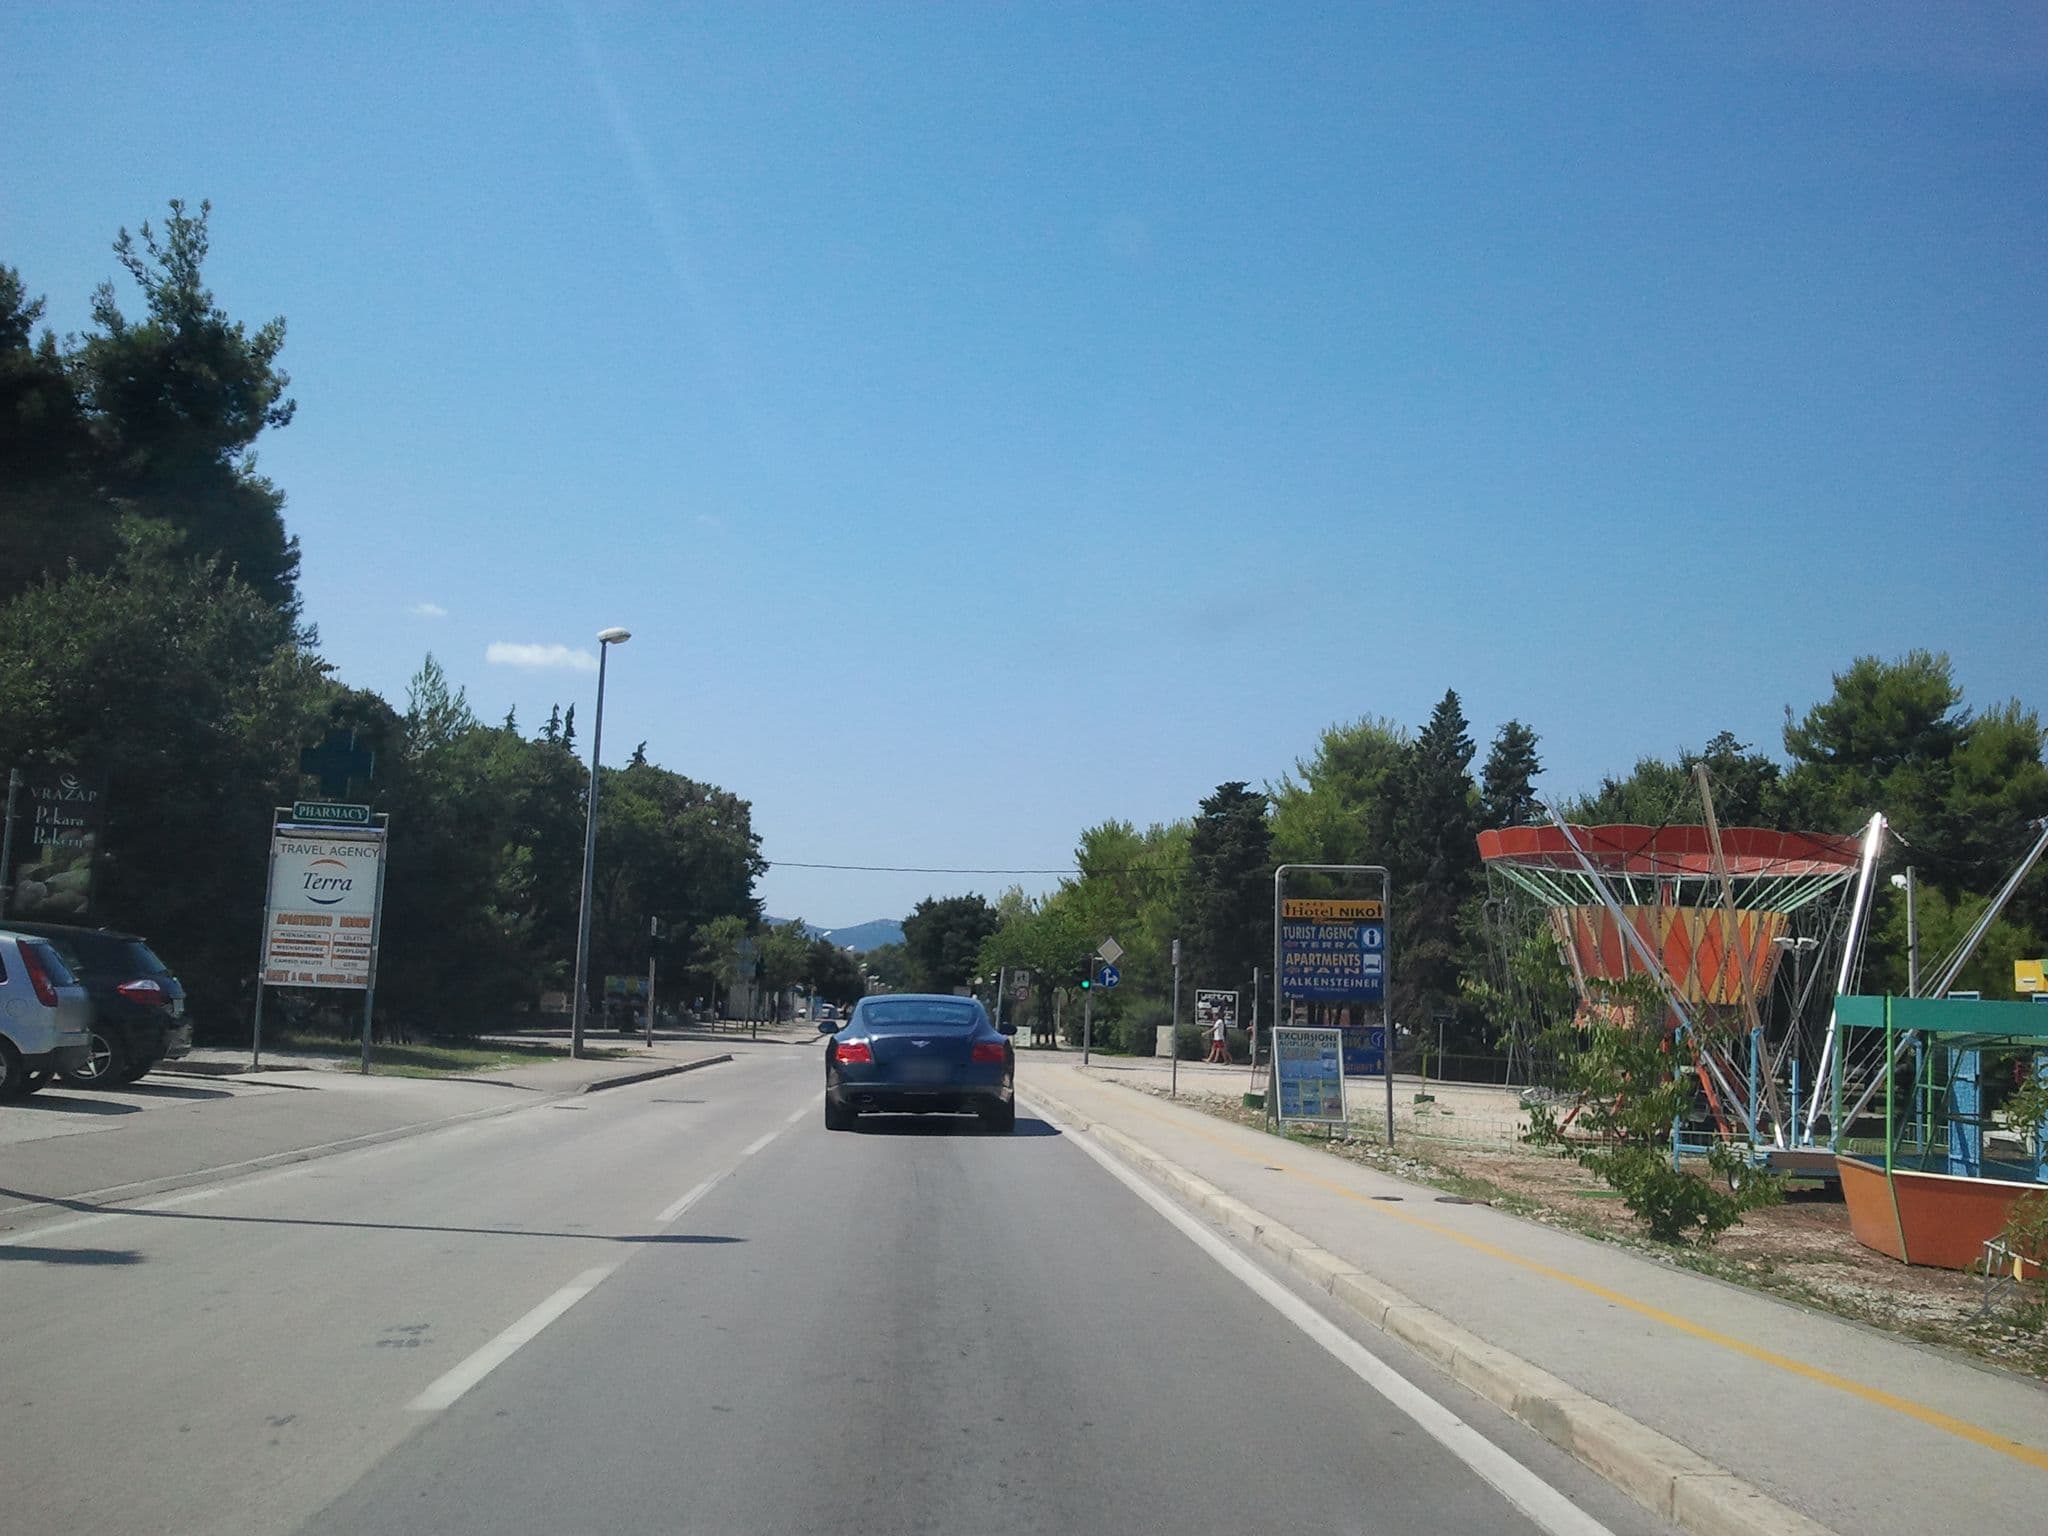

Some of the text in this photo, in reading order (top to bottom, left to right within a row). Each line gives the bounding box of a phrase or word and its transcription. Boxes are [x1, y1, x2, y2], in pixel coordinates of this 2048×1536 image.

[36, 806, 84, 826] Pekara
[298, 805, 365, 819] PHARMACY
[34, 826, 83, 848] Bakery
[280, 843, 380, 858] TRAVEL AGENCY
[303, 872, 352, 891] Terra
[1292, 906, 1375, 917] Hotel NIKO
[1283, 926, 1359, 940] TURIST AGENCY
[1300, 941, 1359, 949] TERRA
[1285, 952, 1361, 967] APARTMENTS
[1283, 977, 1378, 988] FALKENSTEINER
[1278, 1031, 1338, 1042] EXCURSIONS
